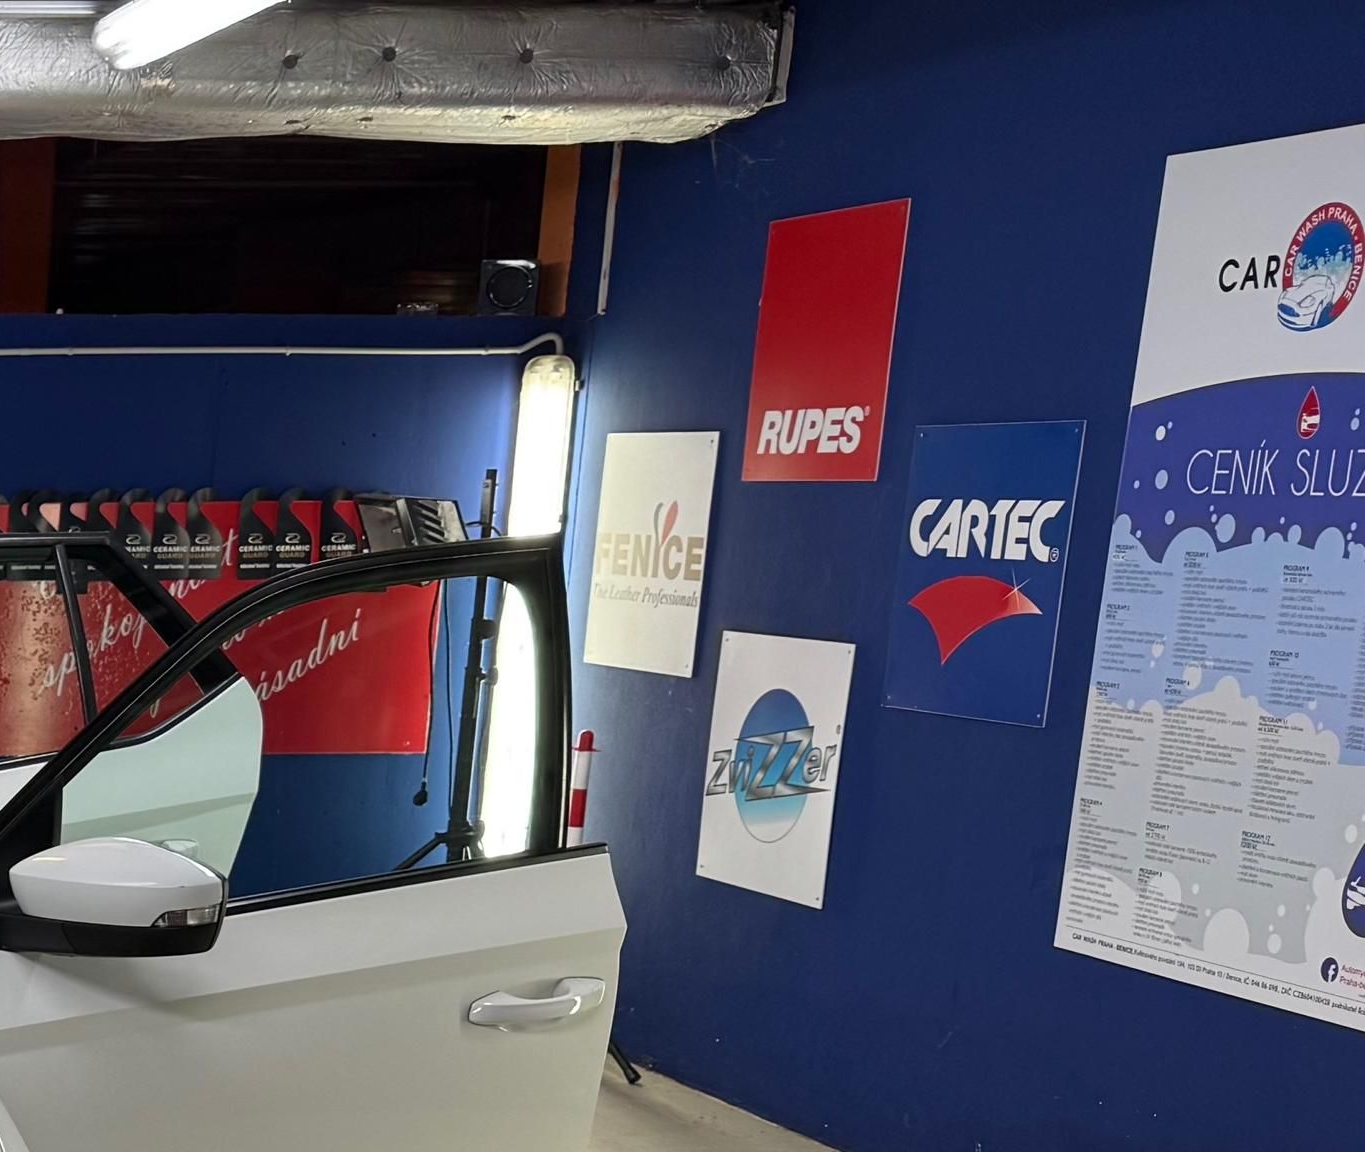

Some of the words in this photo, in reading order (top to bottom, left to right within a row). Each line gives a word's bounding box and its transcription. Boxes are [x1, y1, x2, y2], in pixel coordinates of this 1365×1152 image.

[1284, 245, 1300, 277] CAR
[1296, 209, 1326, 243] WASH
[1327, 206, 1357, 236] PRAHA
[1343, 242, 1364, 301] BENICE
[1218, 254, 1281, 293] CAR
[756, 405, 866, 455] RUPES
[1186, 439, 1280, 496] CENÍK
[153, 545, 189, 553] CERAMIC
[238, 544, 273, 553] CERAMIC
[275, 544, 310, 552] CERAMIC
[321, 543, 356, 552] CERAMIC
[909, 498, 1067, 563] CARTEC
[595, 532, 705, 582] FENICE
[641, 586, 699, 609] Professionals
